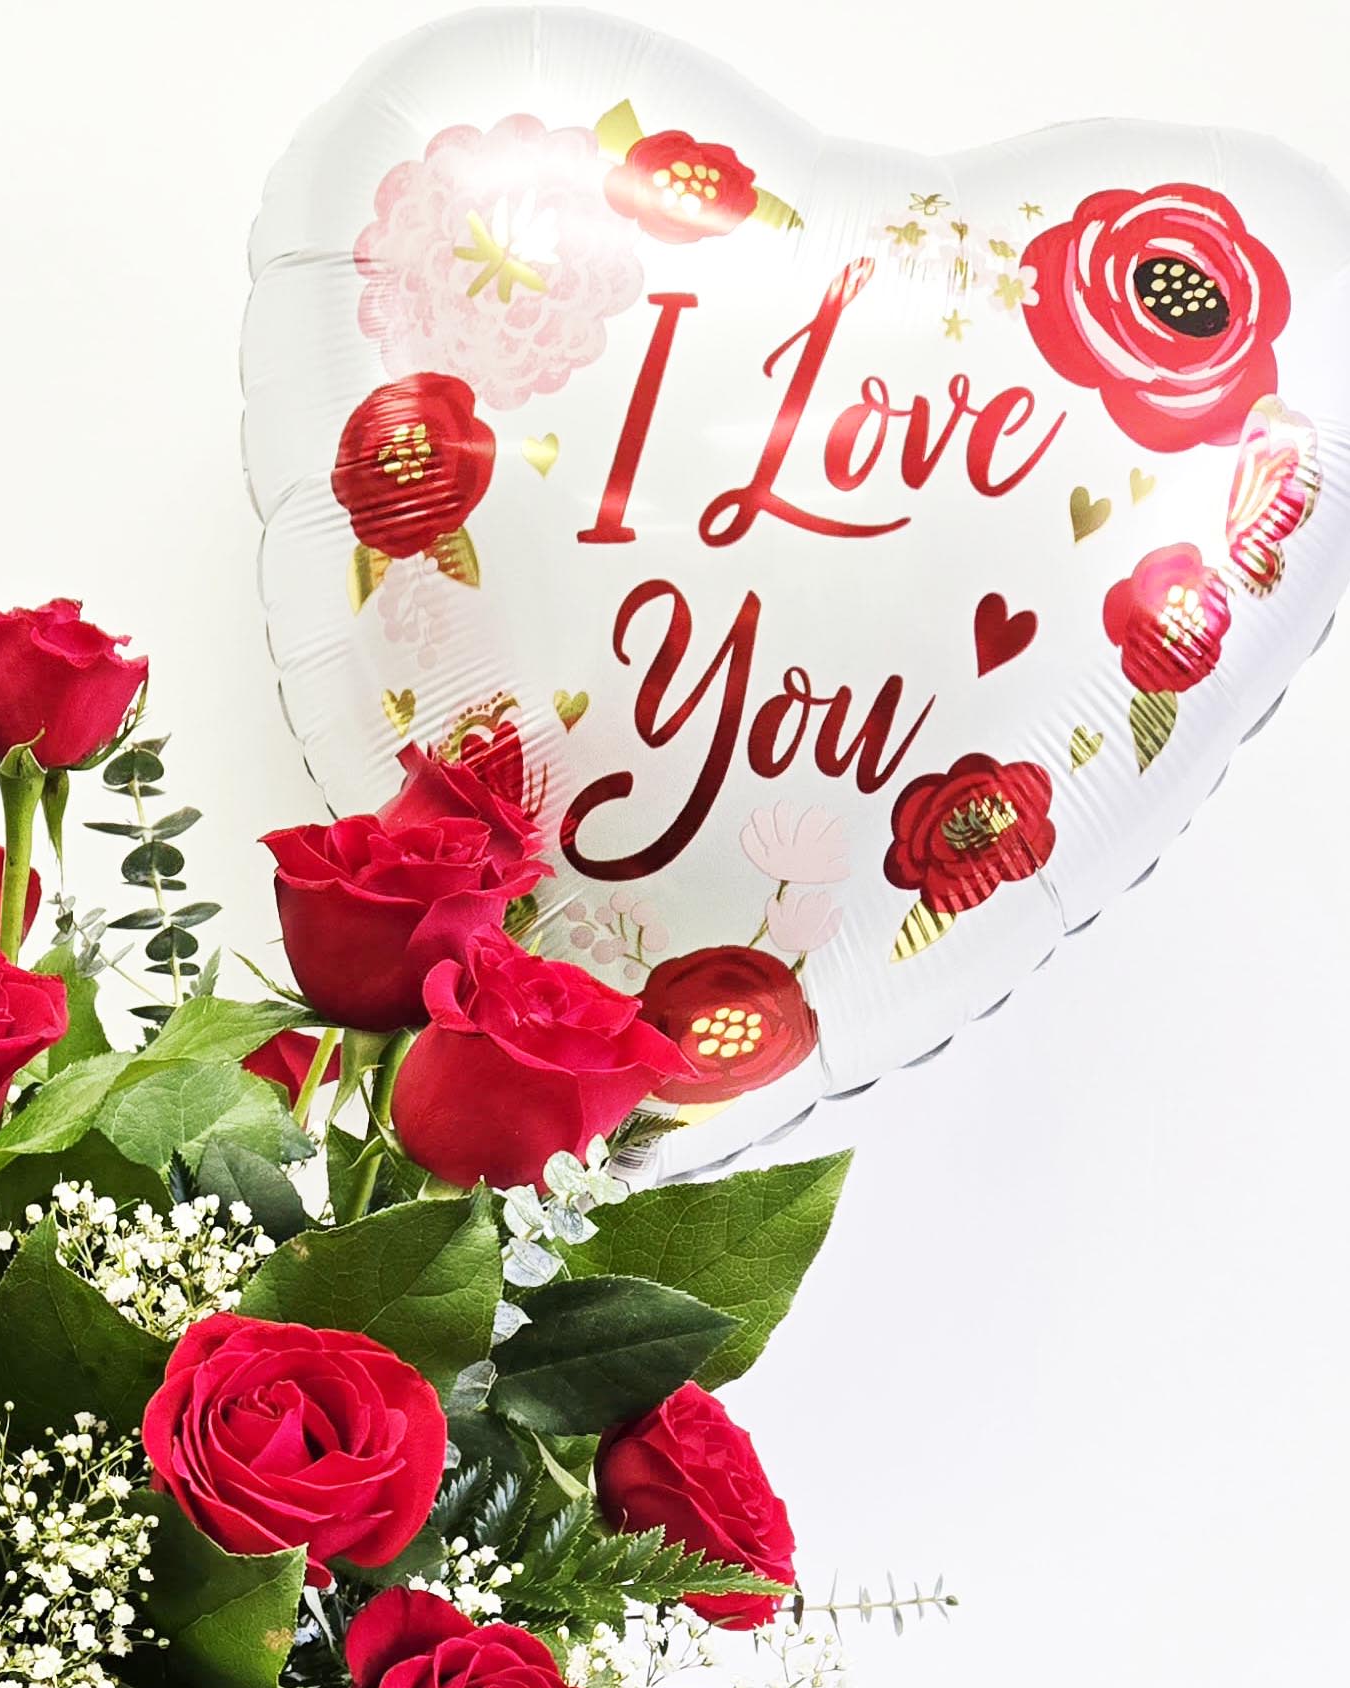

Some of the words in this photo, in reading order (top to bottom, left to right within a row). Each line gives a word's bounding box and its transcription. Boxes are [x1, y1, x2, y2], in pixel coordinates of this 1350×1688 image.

[577, 292, 698, 544] I
[698, 257, 1067, 548] Love
[559, 579, 936, 882] You
